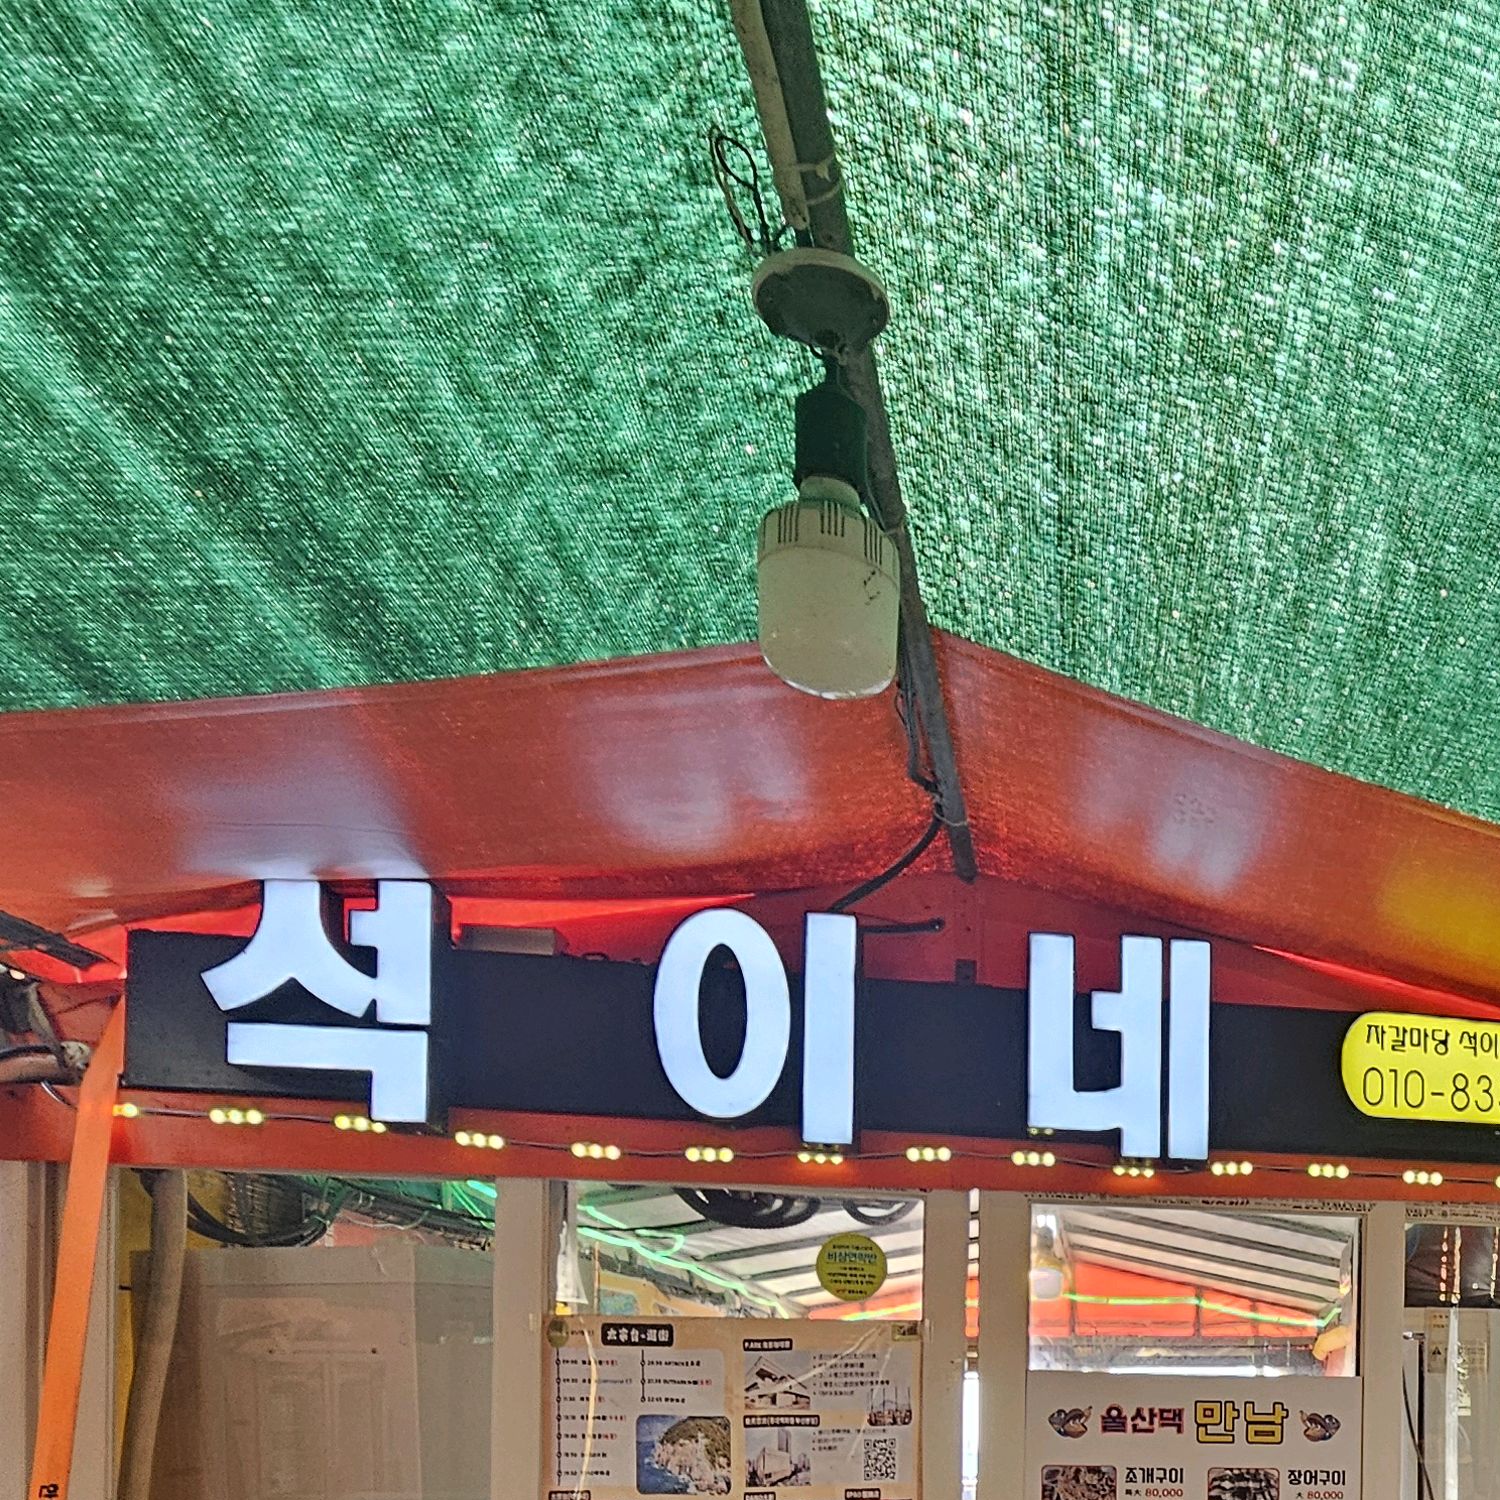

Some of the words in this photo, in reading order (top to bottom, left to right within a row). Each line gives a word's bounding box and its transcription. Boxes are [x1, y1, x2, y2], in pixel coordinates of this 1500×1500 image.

[202, 880, 1211, 1161] 석이네
[1366, 1024, 1450, 1055] 자갈마당
[1100, 1404, 1184, 1435] 울산댁
[1195, 1400, 1289, 1444] 만남
[1125, 1467, 1184, 1484] 조개구이
[1287, 1470, 1346, 1486] 장어구이
[1145, 1488, 1183, 1498] 80,000
[1307, 1491, 1344, 1500] 80,000
